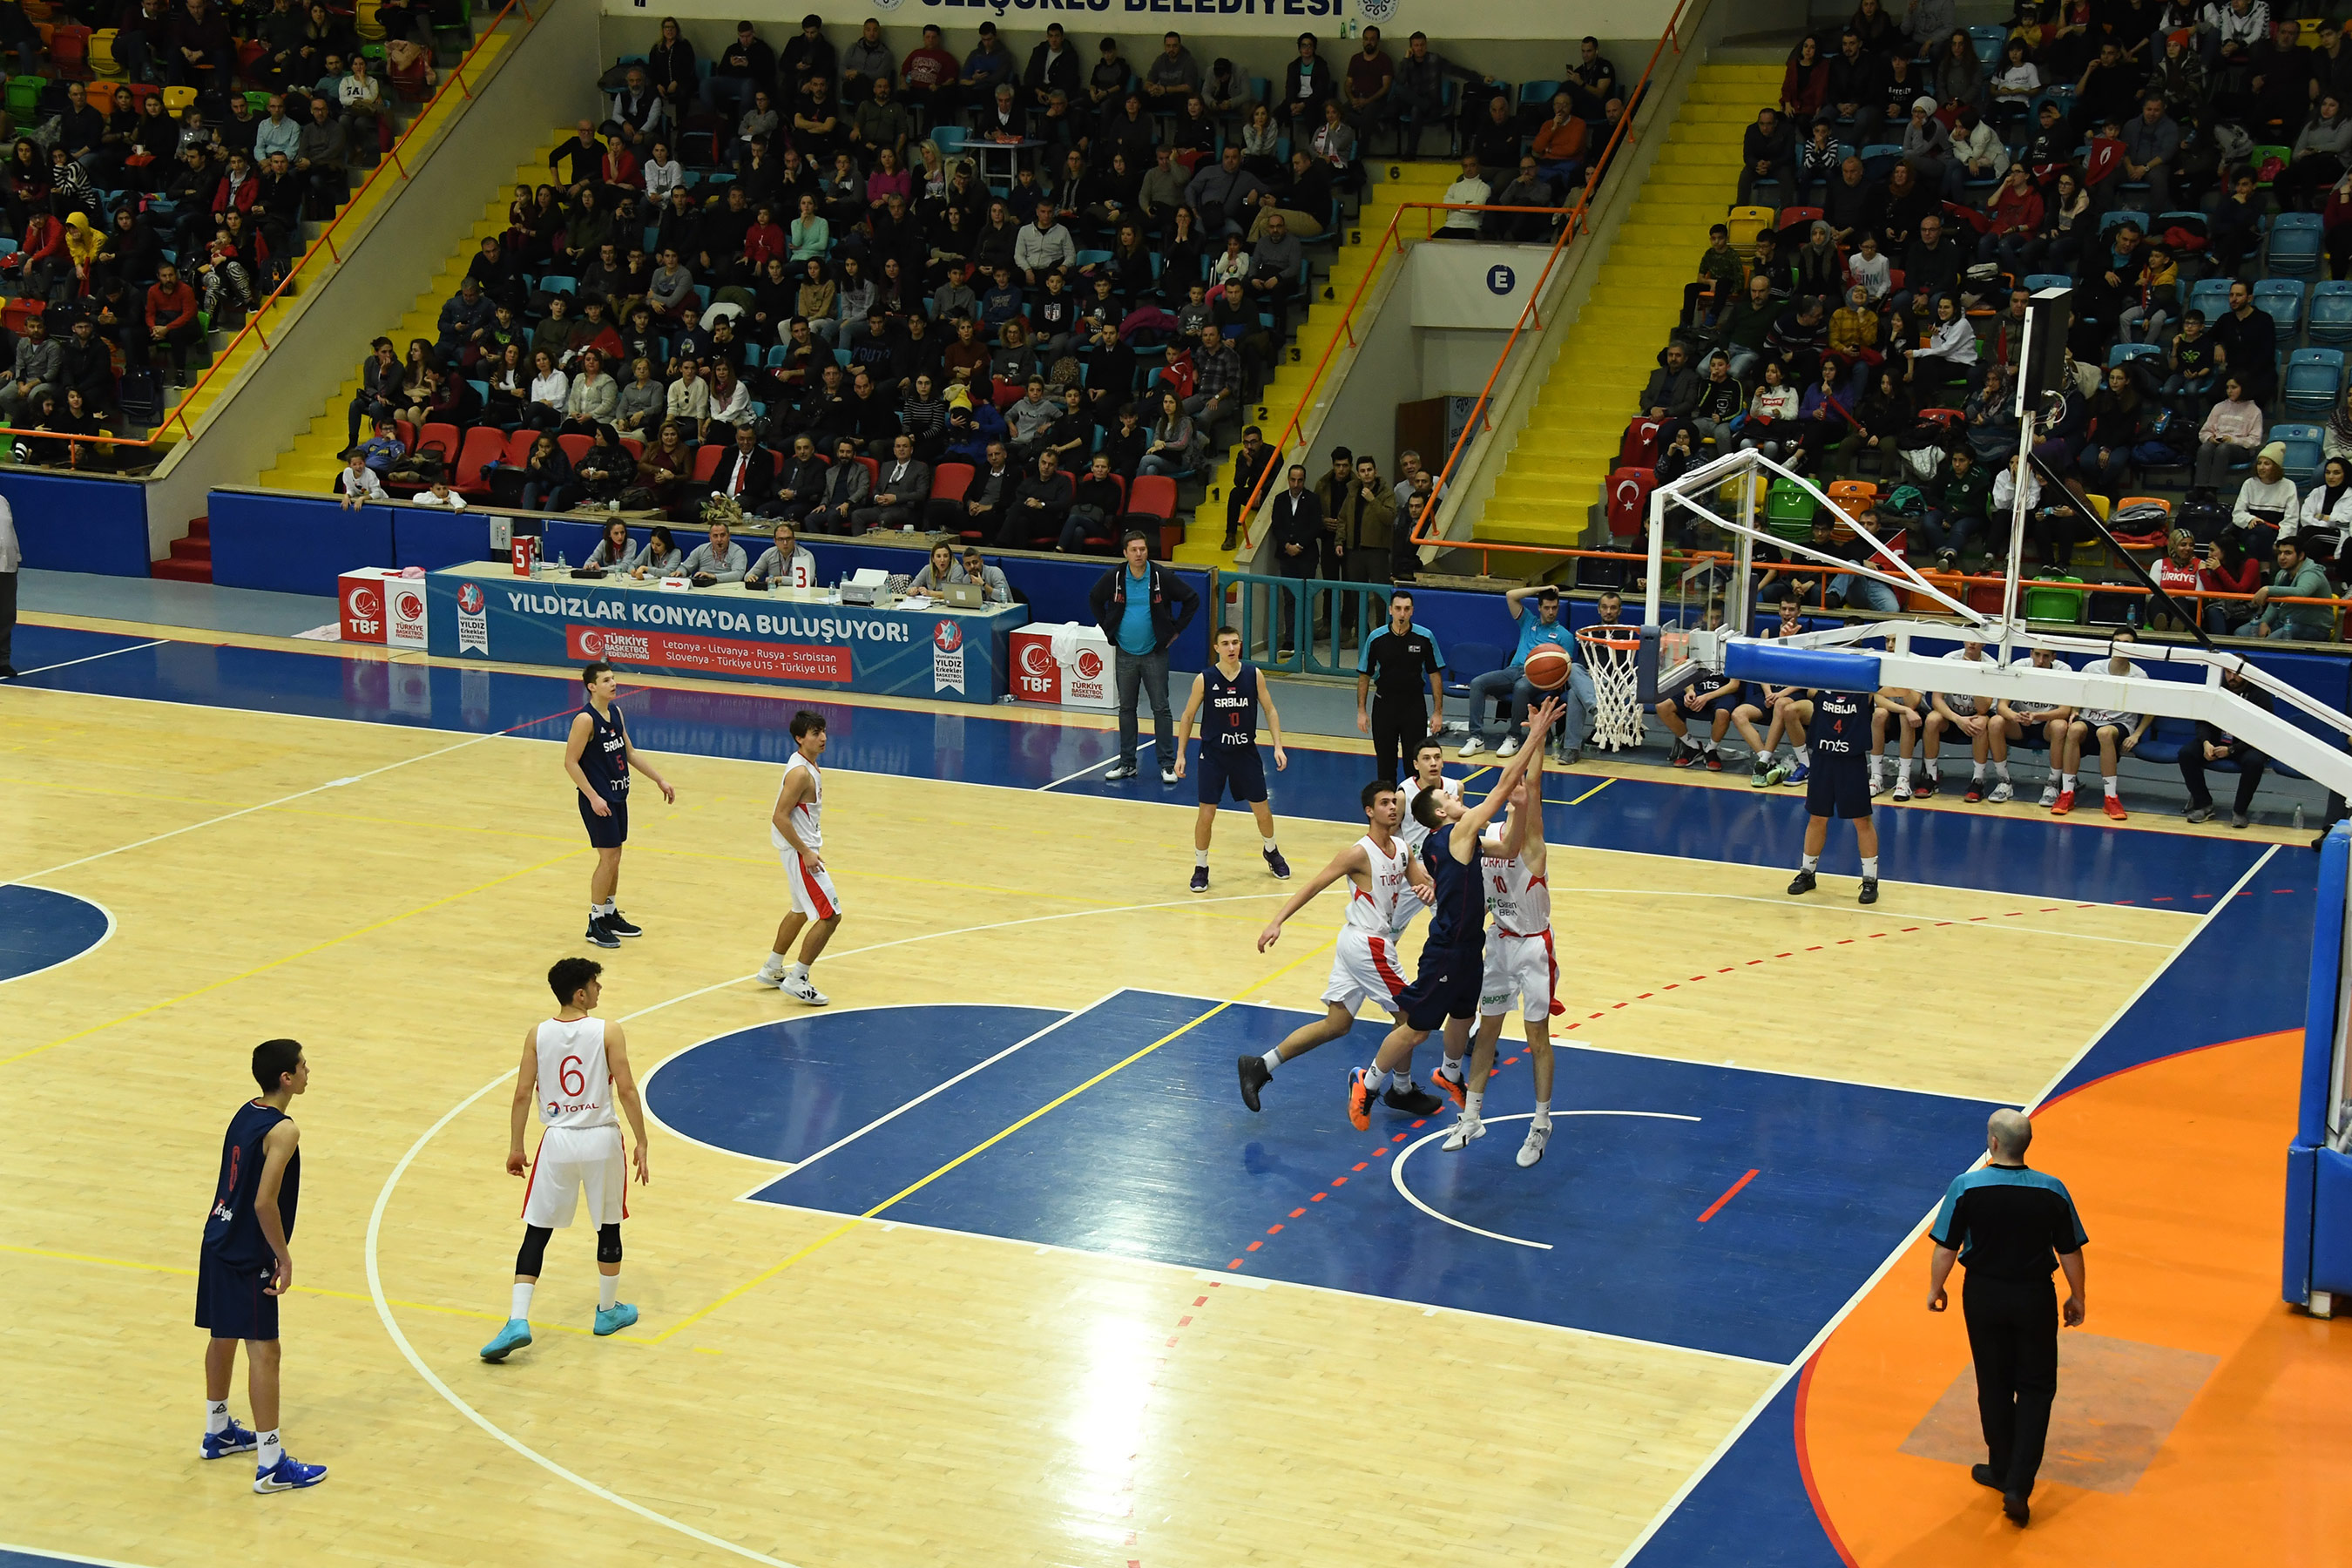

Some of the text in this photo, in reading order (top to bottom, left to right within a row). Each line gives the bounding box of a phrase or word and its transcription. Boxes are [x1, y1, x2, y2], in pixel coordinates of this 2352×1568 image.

[1389, 166, 1401, 179] 6
[1351, 231, 1361, 244] 5
[1495, 271, 1508, 287] E
[1324, 287, 1335, 300] 4
[1291, 348, 1301, 362] 3
[1258, 407, 1267, 420] 2
[1212, 488, 1220, 501] 1
[515, 544, 525, 568] 5
[795, 566, 807, 588] 3
[507, 592, 626, 621] YILDIZLAR
[756, 614, 909, 643] BULUŞUYOR!
[348, 618, 379, 634] TBF
[395, 622, 424, 632] TÜRKİYE
[604, 632, 649, 647] TÜRKİYE
[605, 644, 649, 654] BASKETBOL
[605, 651, 650, 660] FEDERASYONU
[662, 639, 700, 652] Letonya
[708, 645, 749, 657] Litvanya
[756, 649, 785, 660] Rusya
[666, 652, 709, 665] Slovenya
[717, 656, 752, 670] Türkiye
[754, 660, 774, 670] U15
[781, 662, 816, 675] Türkiye
[818, 665, 837, 674] U16
[1020, 676, 1052, 693] TBF
[1071, 681, 1103, 690] TÜRKİYE
[1214, 698, 1249, 707] SRBIJA
[1821, 700, 1857, 713] SRBIJA
[1833, 719, 1842, 733] 4
[1221, 732, 1248, 745] mts
[1819, 739, 1849, 753] mts
[616, 754, 625, 771] 5
[1493, 875, 1508, 894] 10
[559, 1055, 585, 1097] 6
[229, 1145, 240, 1192] 6
